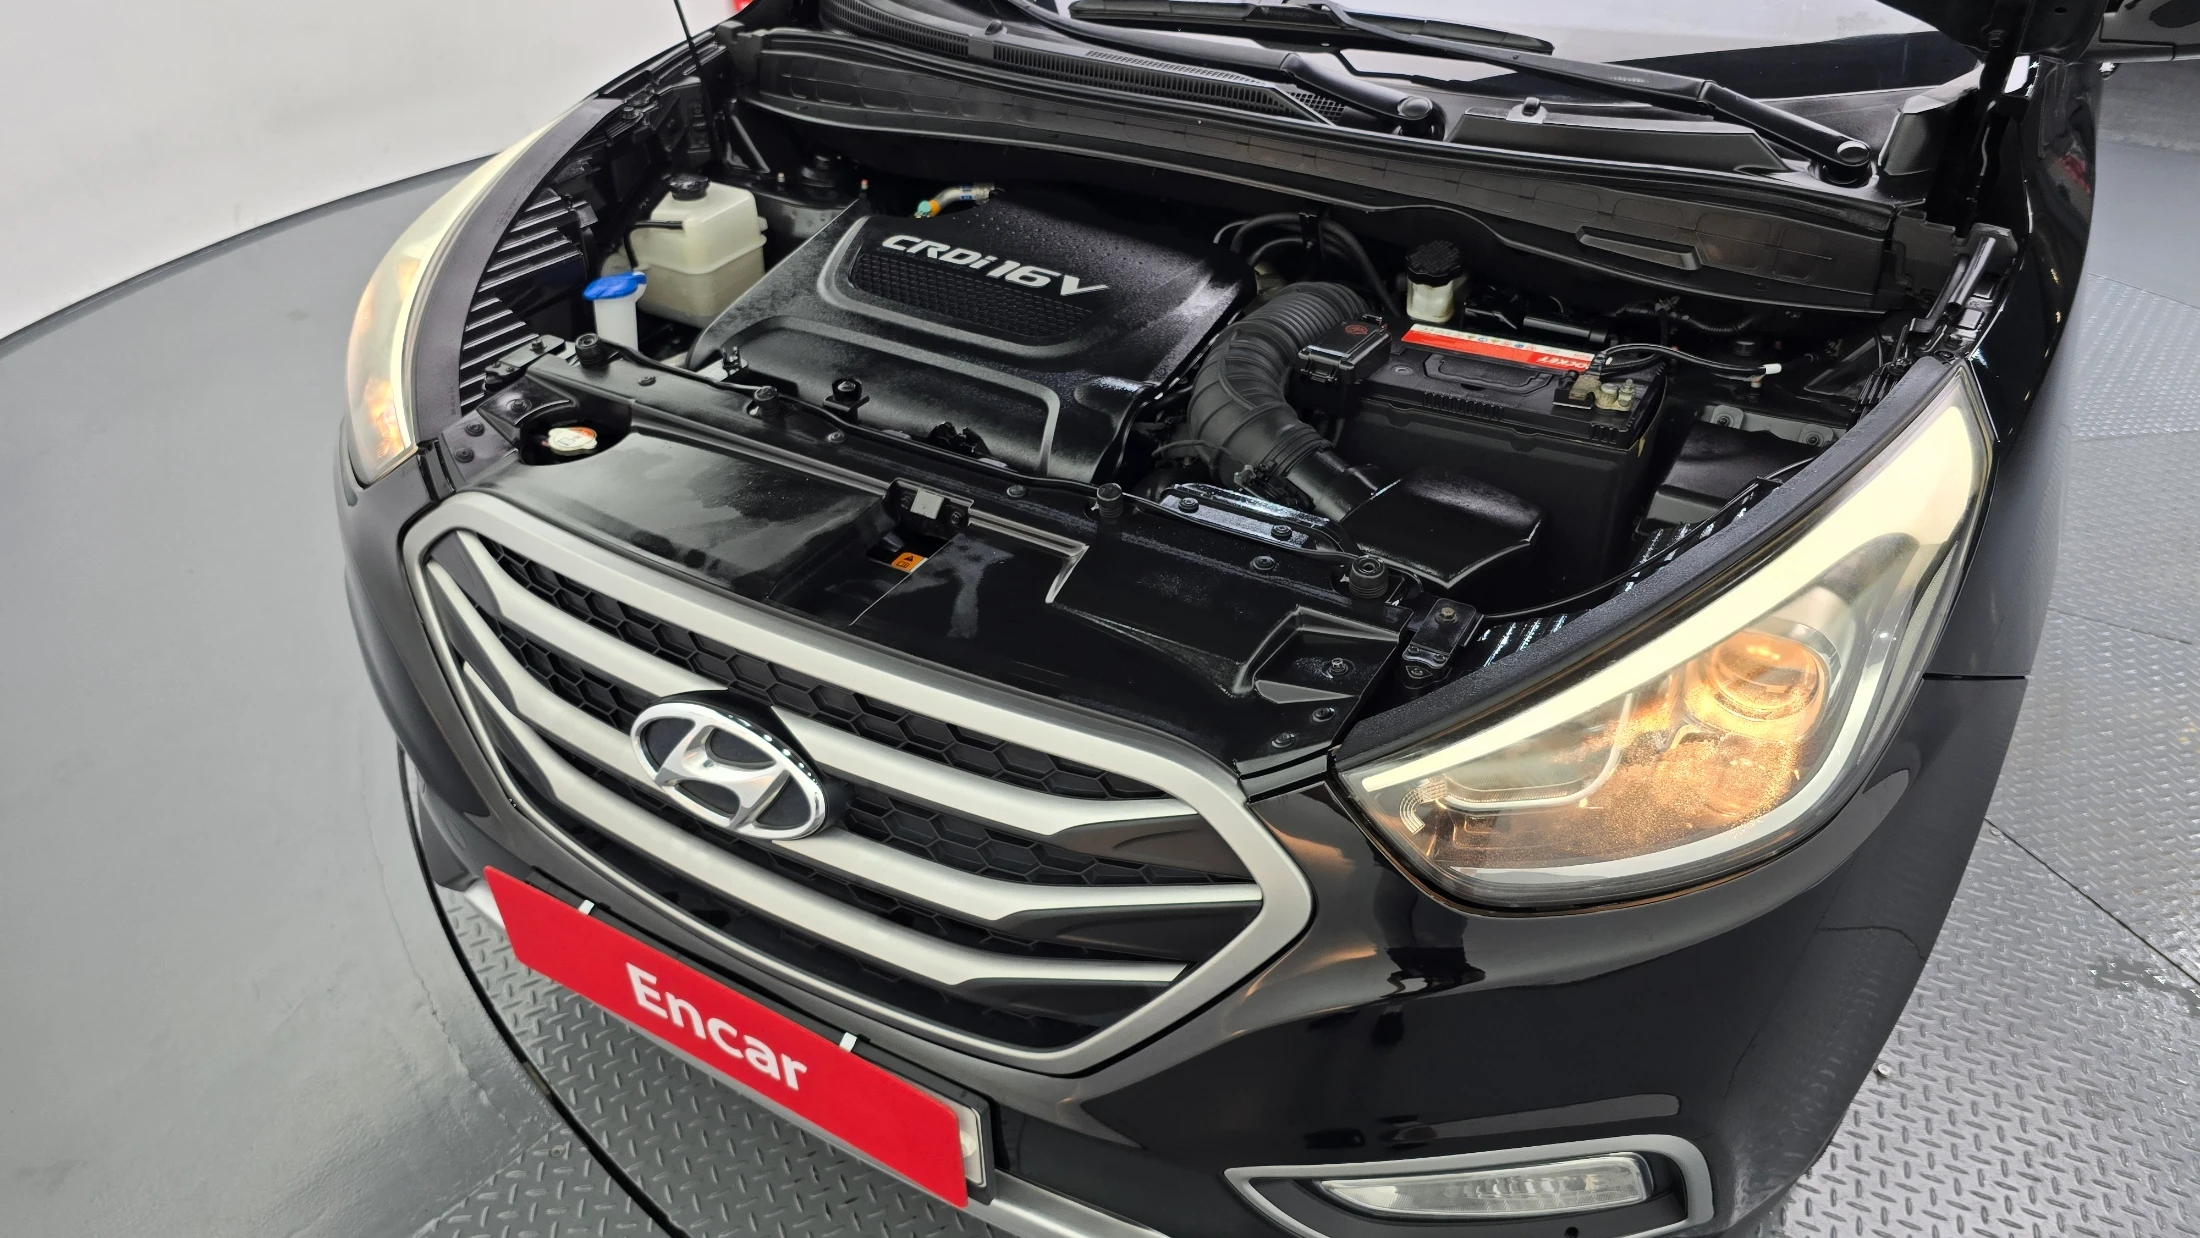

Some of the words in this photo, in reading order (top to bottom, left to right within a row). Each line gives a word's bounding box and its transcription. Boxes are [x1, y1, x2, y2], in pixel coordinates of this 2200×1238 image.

[882, 234, 998, 270] CRDi
[986, 259, 1109, 297] 16V
[626, 962, 808, 1091] Encar
